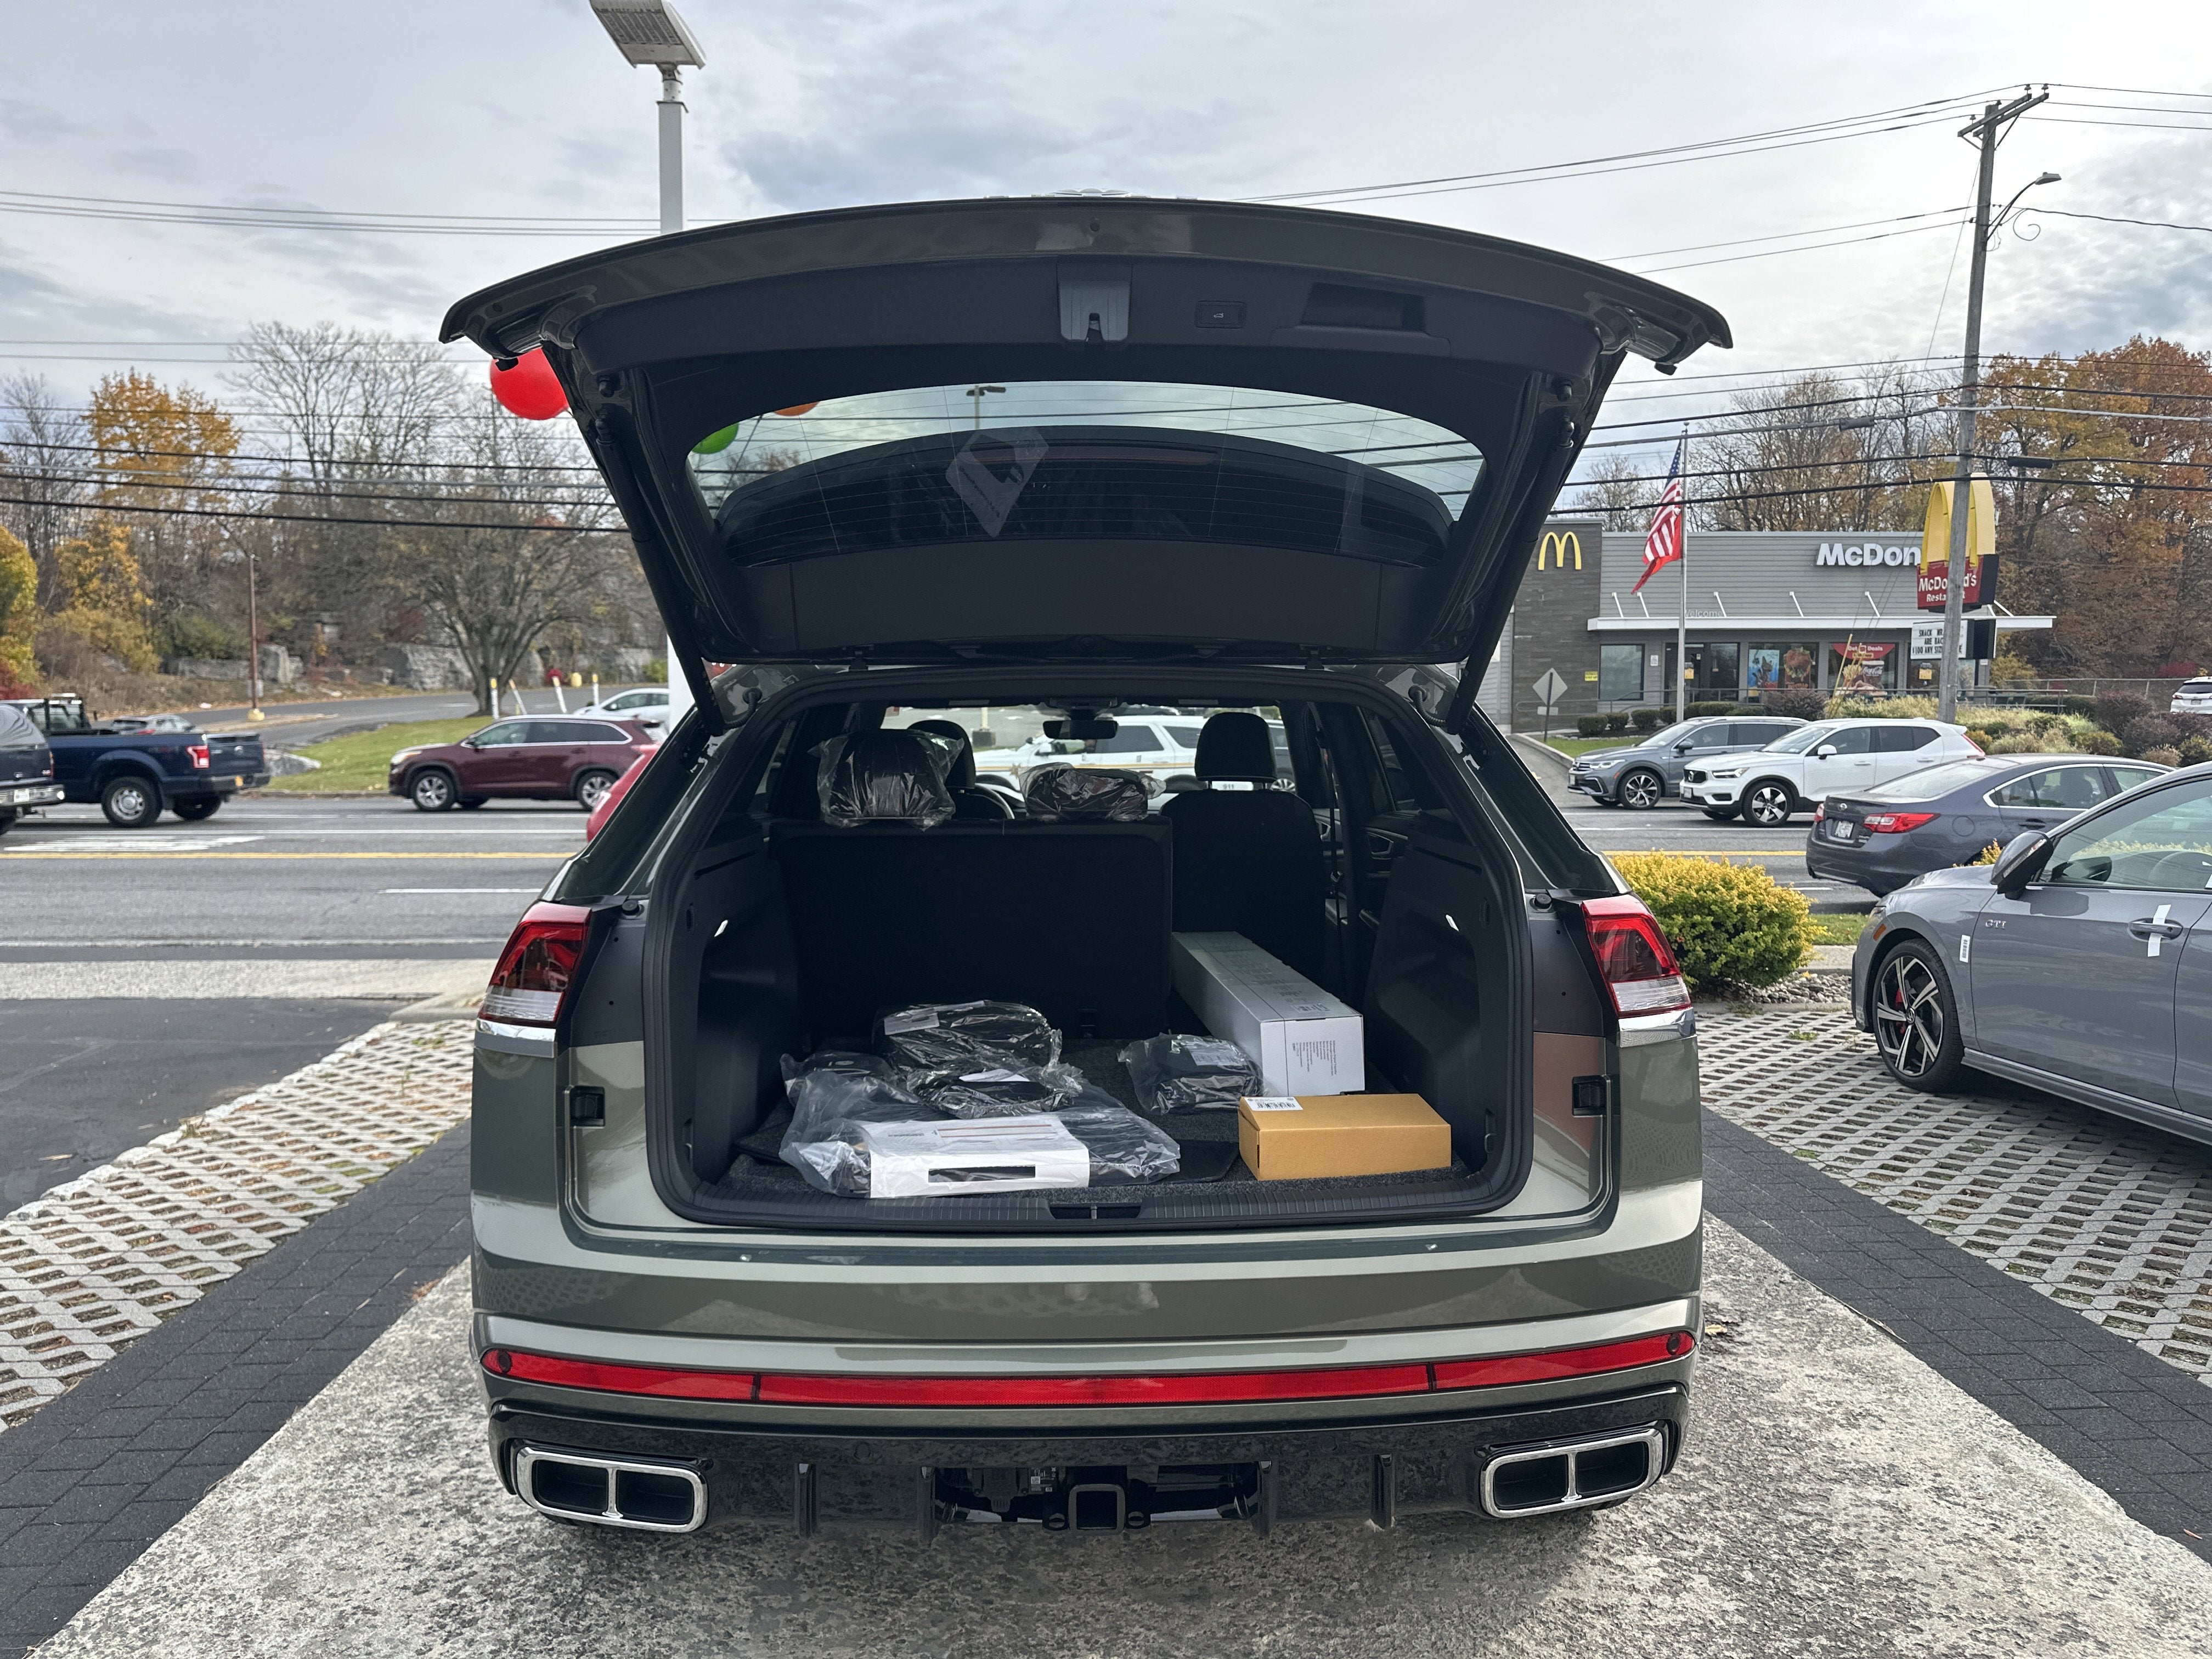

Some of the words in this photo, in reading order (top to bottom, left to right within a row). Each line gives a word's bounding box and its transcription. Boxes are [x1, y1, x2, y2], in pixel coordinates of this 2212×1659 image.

[1816, 543, 1921, 566] McDon
[1918, 573, 1977, 591] McDod's
[1926, 590, 1965, 602] Restat
[1985, 919, 2006, 929] GTI
